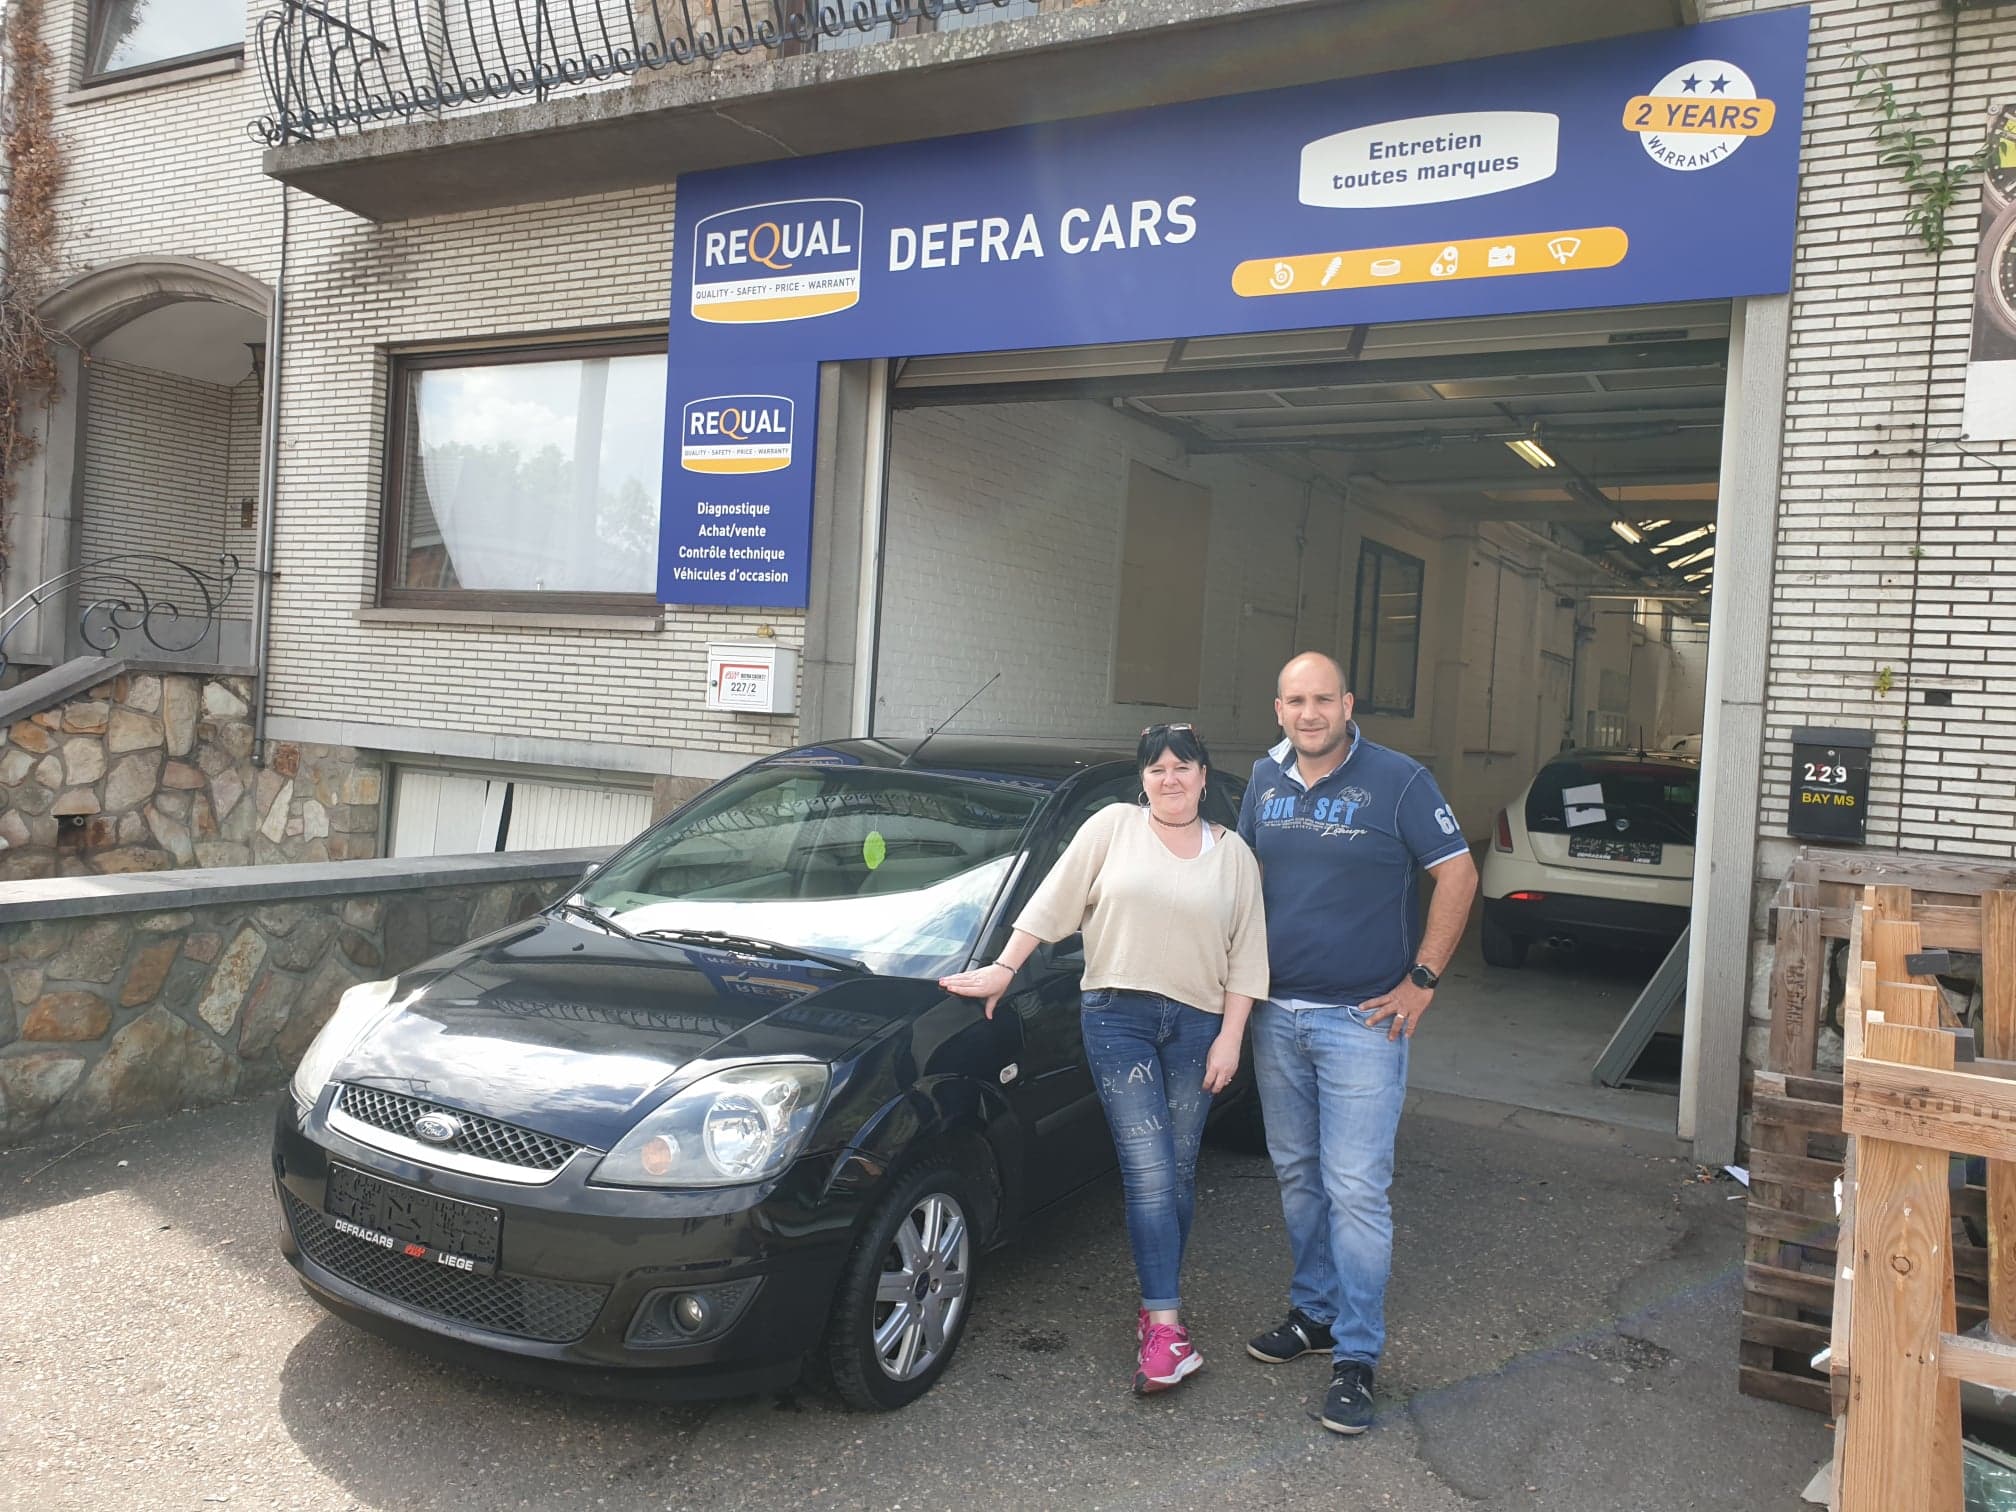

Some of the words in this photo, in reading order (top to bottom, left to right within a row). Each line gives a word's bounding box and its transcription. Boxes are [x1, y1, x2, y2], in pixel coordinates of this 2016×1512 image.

[1635, 103, 1653, 126] 2
[1667, 103, 1761, 130] YEARS
[1368, 132, 1482, 160] Entretien
[1648, 135, 1729, 167] WARRANTY
[1332, 168, 1408, 190] toutes
[1417, 155, 1520, 180] marques
[705, 218, 851, 270] REQUAL
[889, 213, 1044, 272] DEFRA
[1060, 195, 1197, 254] CARS
[695, 288, 729, 300] QUALITY
[736, 284, 768, 296] SAFETY
[775, 281, 800, 293] PRICE
[808, 277, 856, 290] WARRANTY
[690, 408, 787, 441] REQUAL
[697, 501, 771, 518] Diagnostique
[698, 522, 767, 538] Achat/vente
[678, 545, 727, 559] Contrôle
[729, 546, 786, 563] technique
[673, 566, 727, 581] Véhicules
[729, 568, 789, 583] d'occasion
[730, 682, 757, 694] 227/2
[1803, 762, 1848, 784] 229
[1262, 795, 1297, 820] SUN
[1313, 796, 1360, 826] SET
[1801, 791, 1831, 805] BAY
[1833, 795, 1856, 807] MS
[334, 1219, 394, 1249] DEFRACARS
[438, 1252, 474, 1272] LIEGE
